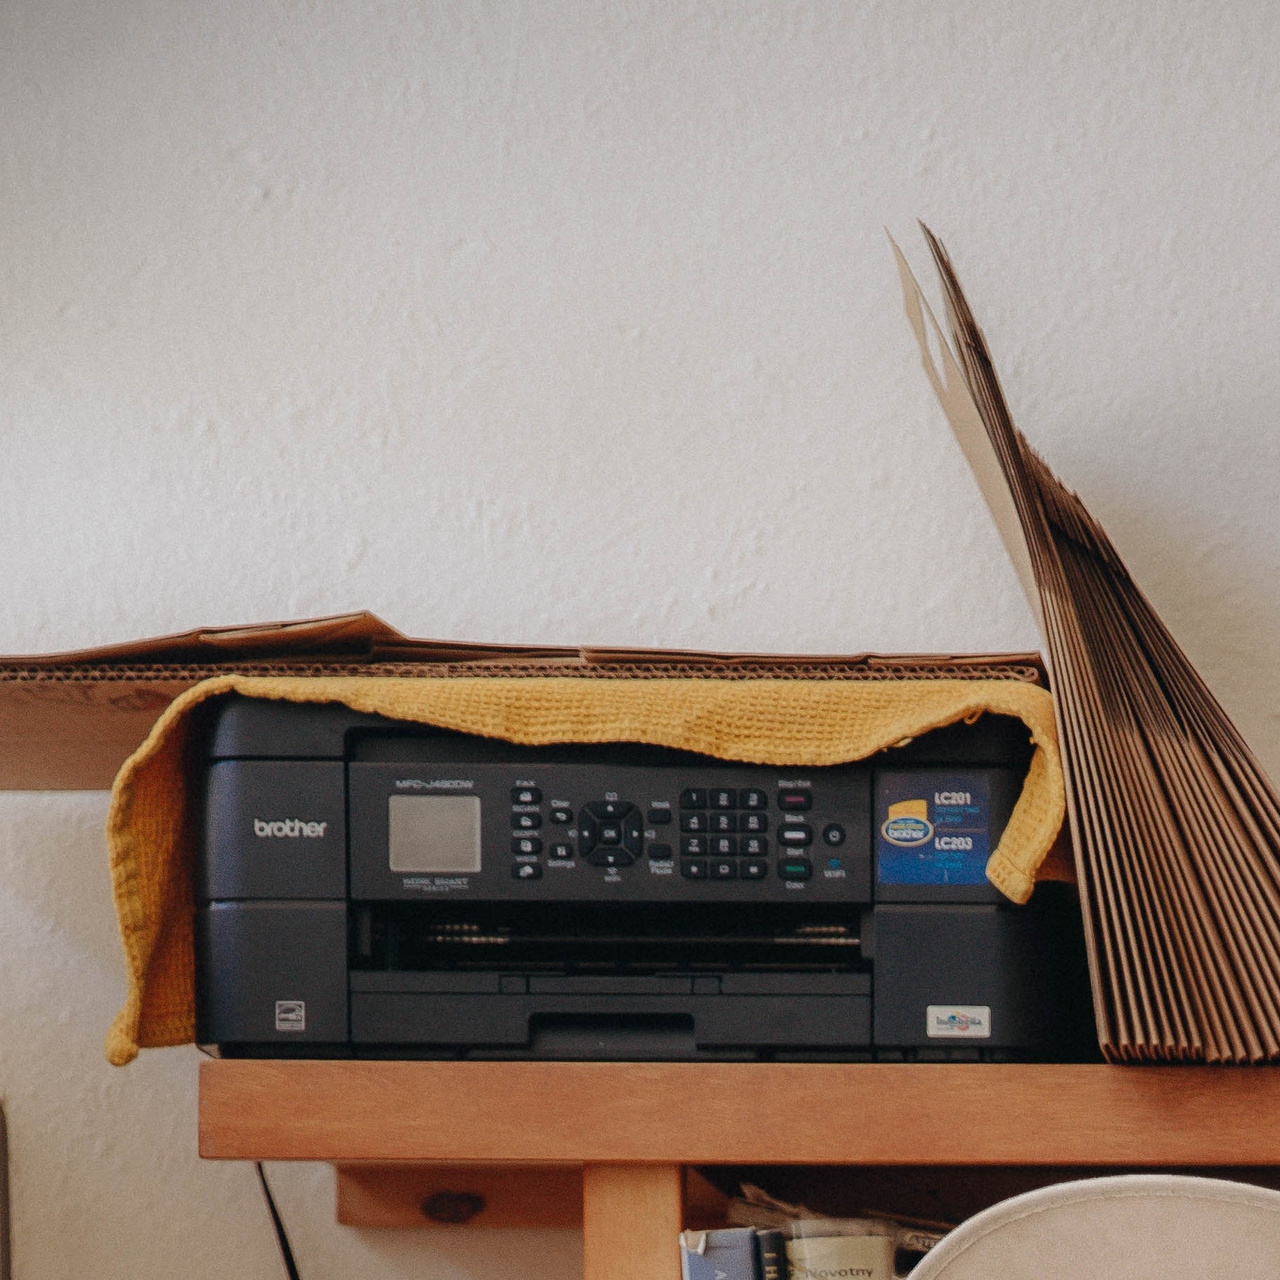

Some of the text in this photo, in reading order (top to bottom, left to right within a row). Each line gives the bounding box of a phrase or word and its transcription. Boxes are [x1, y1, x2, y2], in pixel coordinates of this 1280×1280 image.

[934, 791, 971, 805] LC201
[252, 817, 328, 838] brother
[934, 836, 973, 850] LC203
[805, 1267, 874, 1279] Novotny
